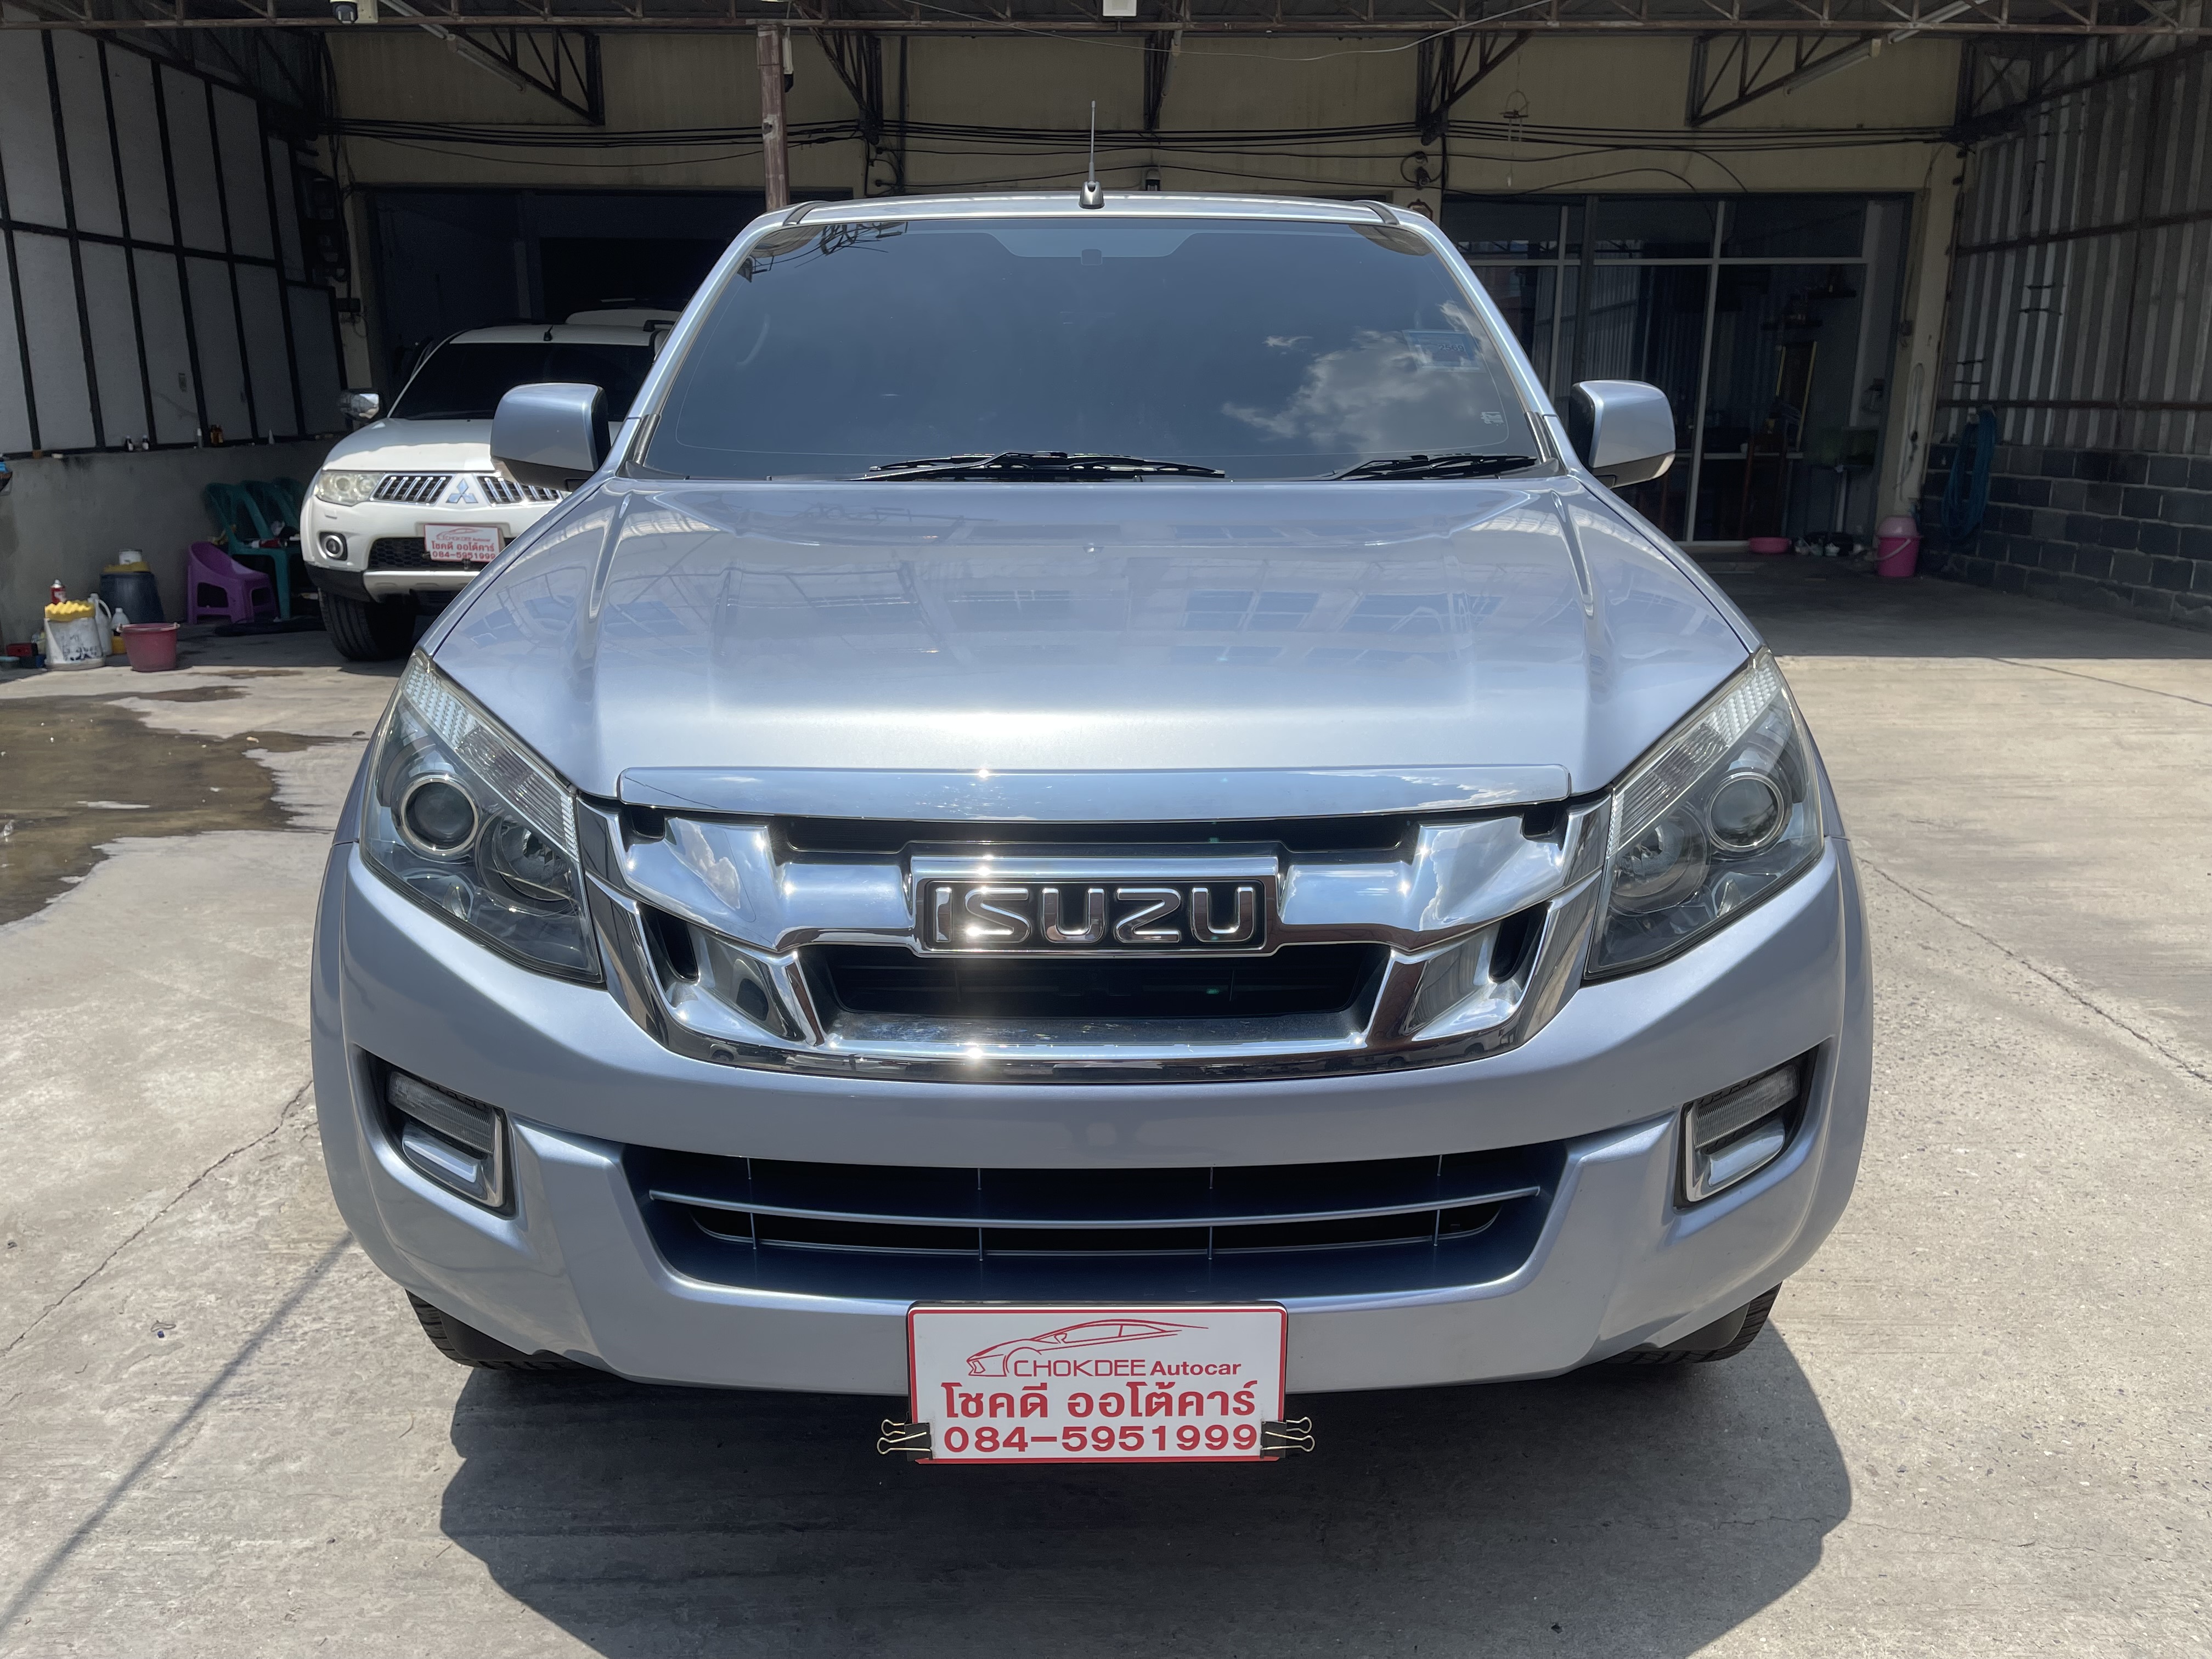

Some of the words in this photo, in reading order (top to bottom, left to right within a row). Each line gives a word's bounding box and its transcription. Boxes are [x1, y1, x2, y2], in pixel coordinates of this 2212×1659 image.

[1438, 344, 1465, 352] 2569
[935, 887, 1255, 944] ISUZU
[1014, 1359, 1146, 1377] CHOKDEE
[1150, 1360, 1242, 1376] Autocar
[941, 1382, 1048, 1418] โชคดี
[1067, 1380, 1258, 1418] ออโต้คาร์
[944, 1424, 1257, 1453] 084-5951999
